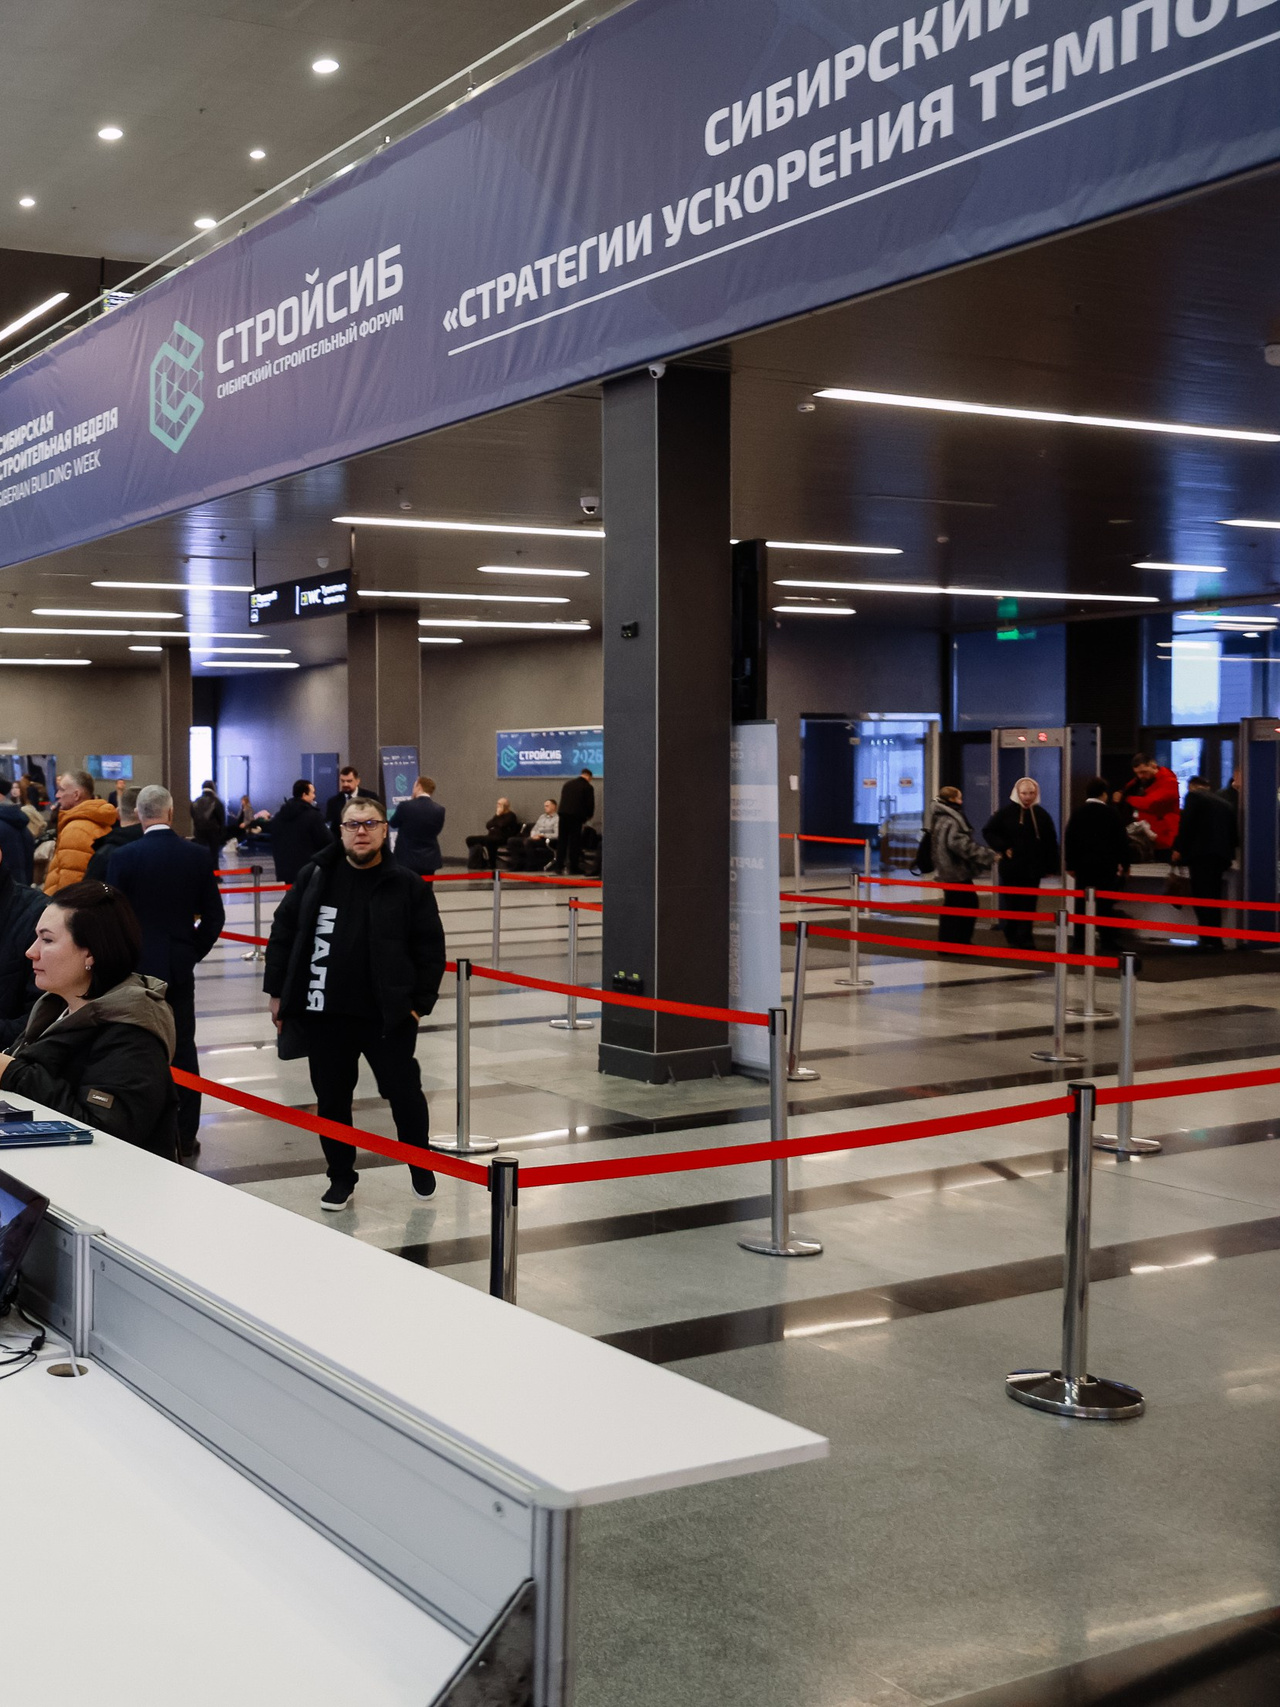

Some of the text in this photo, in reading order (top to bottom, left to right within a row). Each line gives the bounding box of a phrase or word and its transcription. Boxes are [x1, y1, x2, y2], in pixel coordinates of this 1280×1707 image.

[442, 0, 1280, 334] «СТРАТЕГИИ УСКОРЕНИЯ ТЕМПО
[216, 243, 404, 374] СТРОЙСИБ
[217, 305, 404, 399] СИБИРСКИЙ СТРОИТЕЛЬНЫЙ ФОРУМ
[73, 406, 119, 448] НЕДЕЛЯ
[31, 460, 72, 497] BUILDING
[73, 449, 101, 478] WEEK
[518, 747, 562, 760] СТРОЙСИБ
[572, 748, 603, 765] 2026
